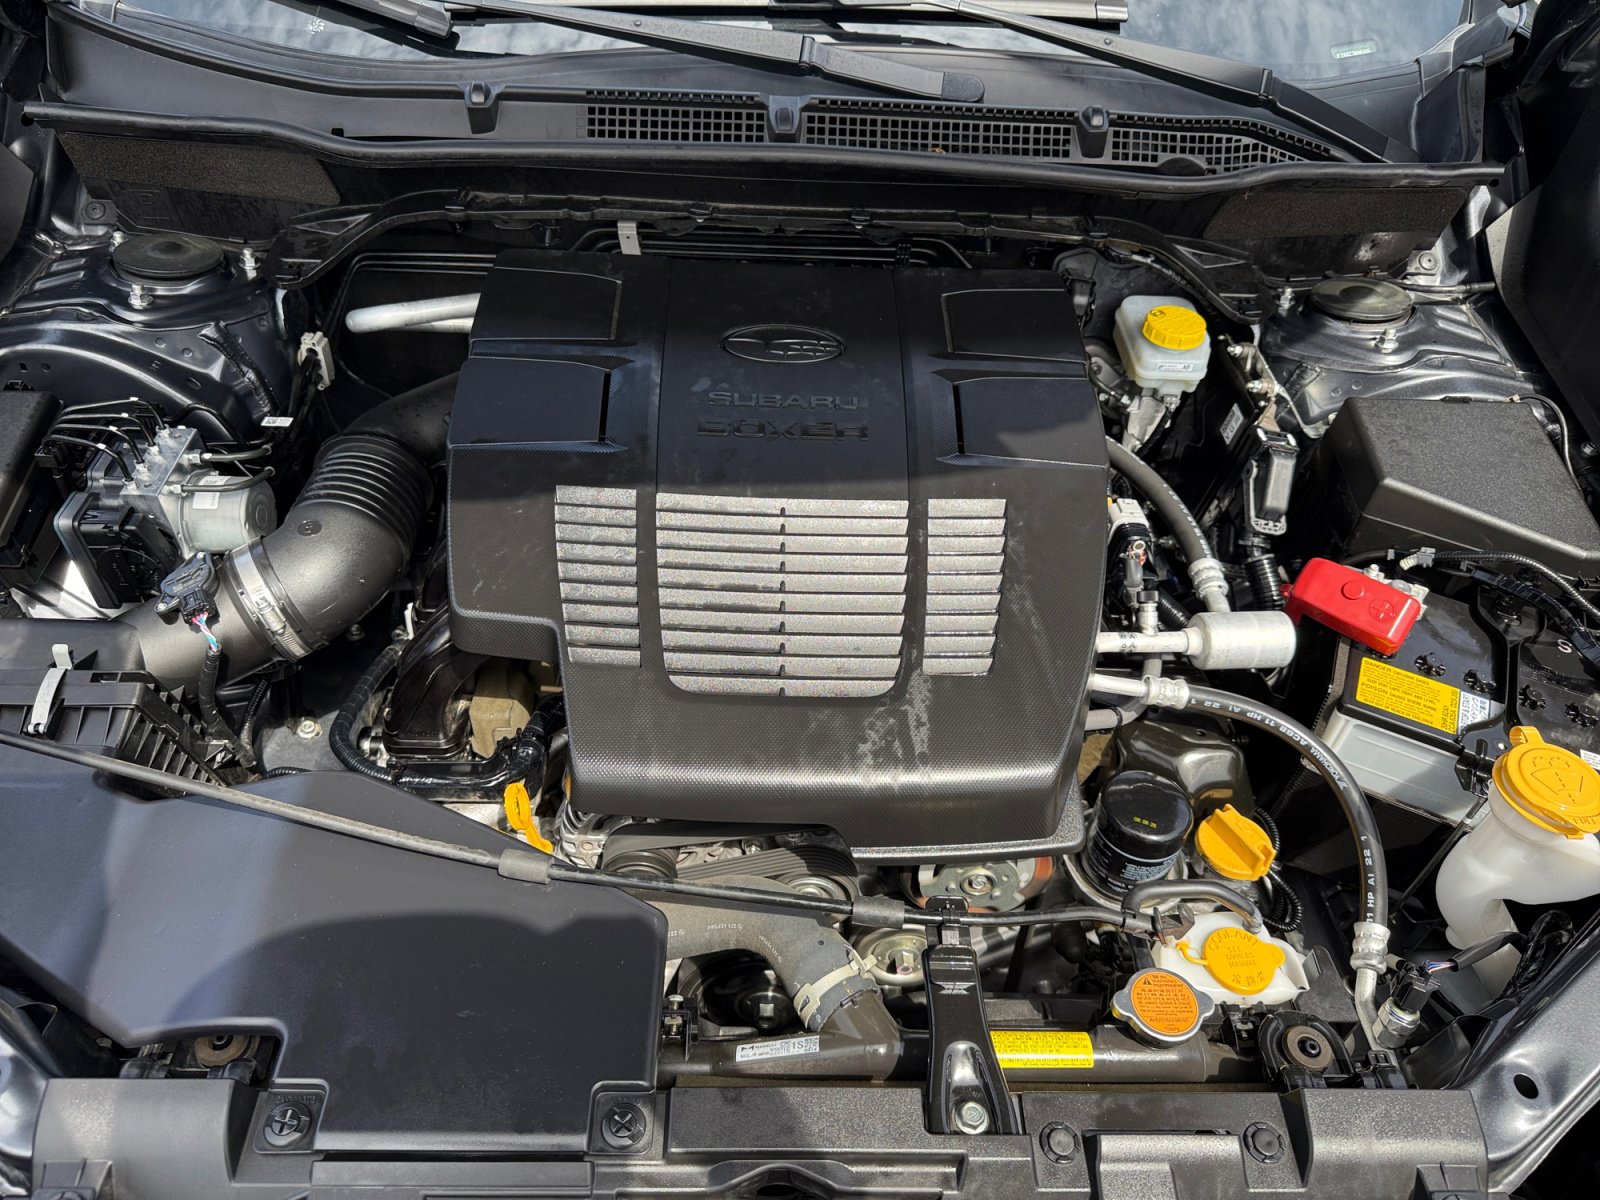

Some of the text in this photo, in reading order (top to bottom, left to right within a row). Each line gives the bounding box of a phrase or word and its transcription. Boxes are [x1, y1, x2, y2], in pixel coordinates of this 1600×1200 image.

[708, 391, 858, 411] SUBARU
[697, 417, 869, 441] BOXER
[1365, 661, 1392, 673] DANGER
[1361, 682, 1388, 695] POISON
[1310, 746, 1341, 785] YOKOHAMA
[1362, 849, 1373, 866] 22
[1367, 891, 1375, 908] HP
